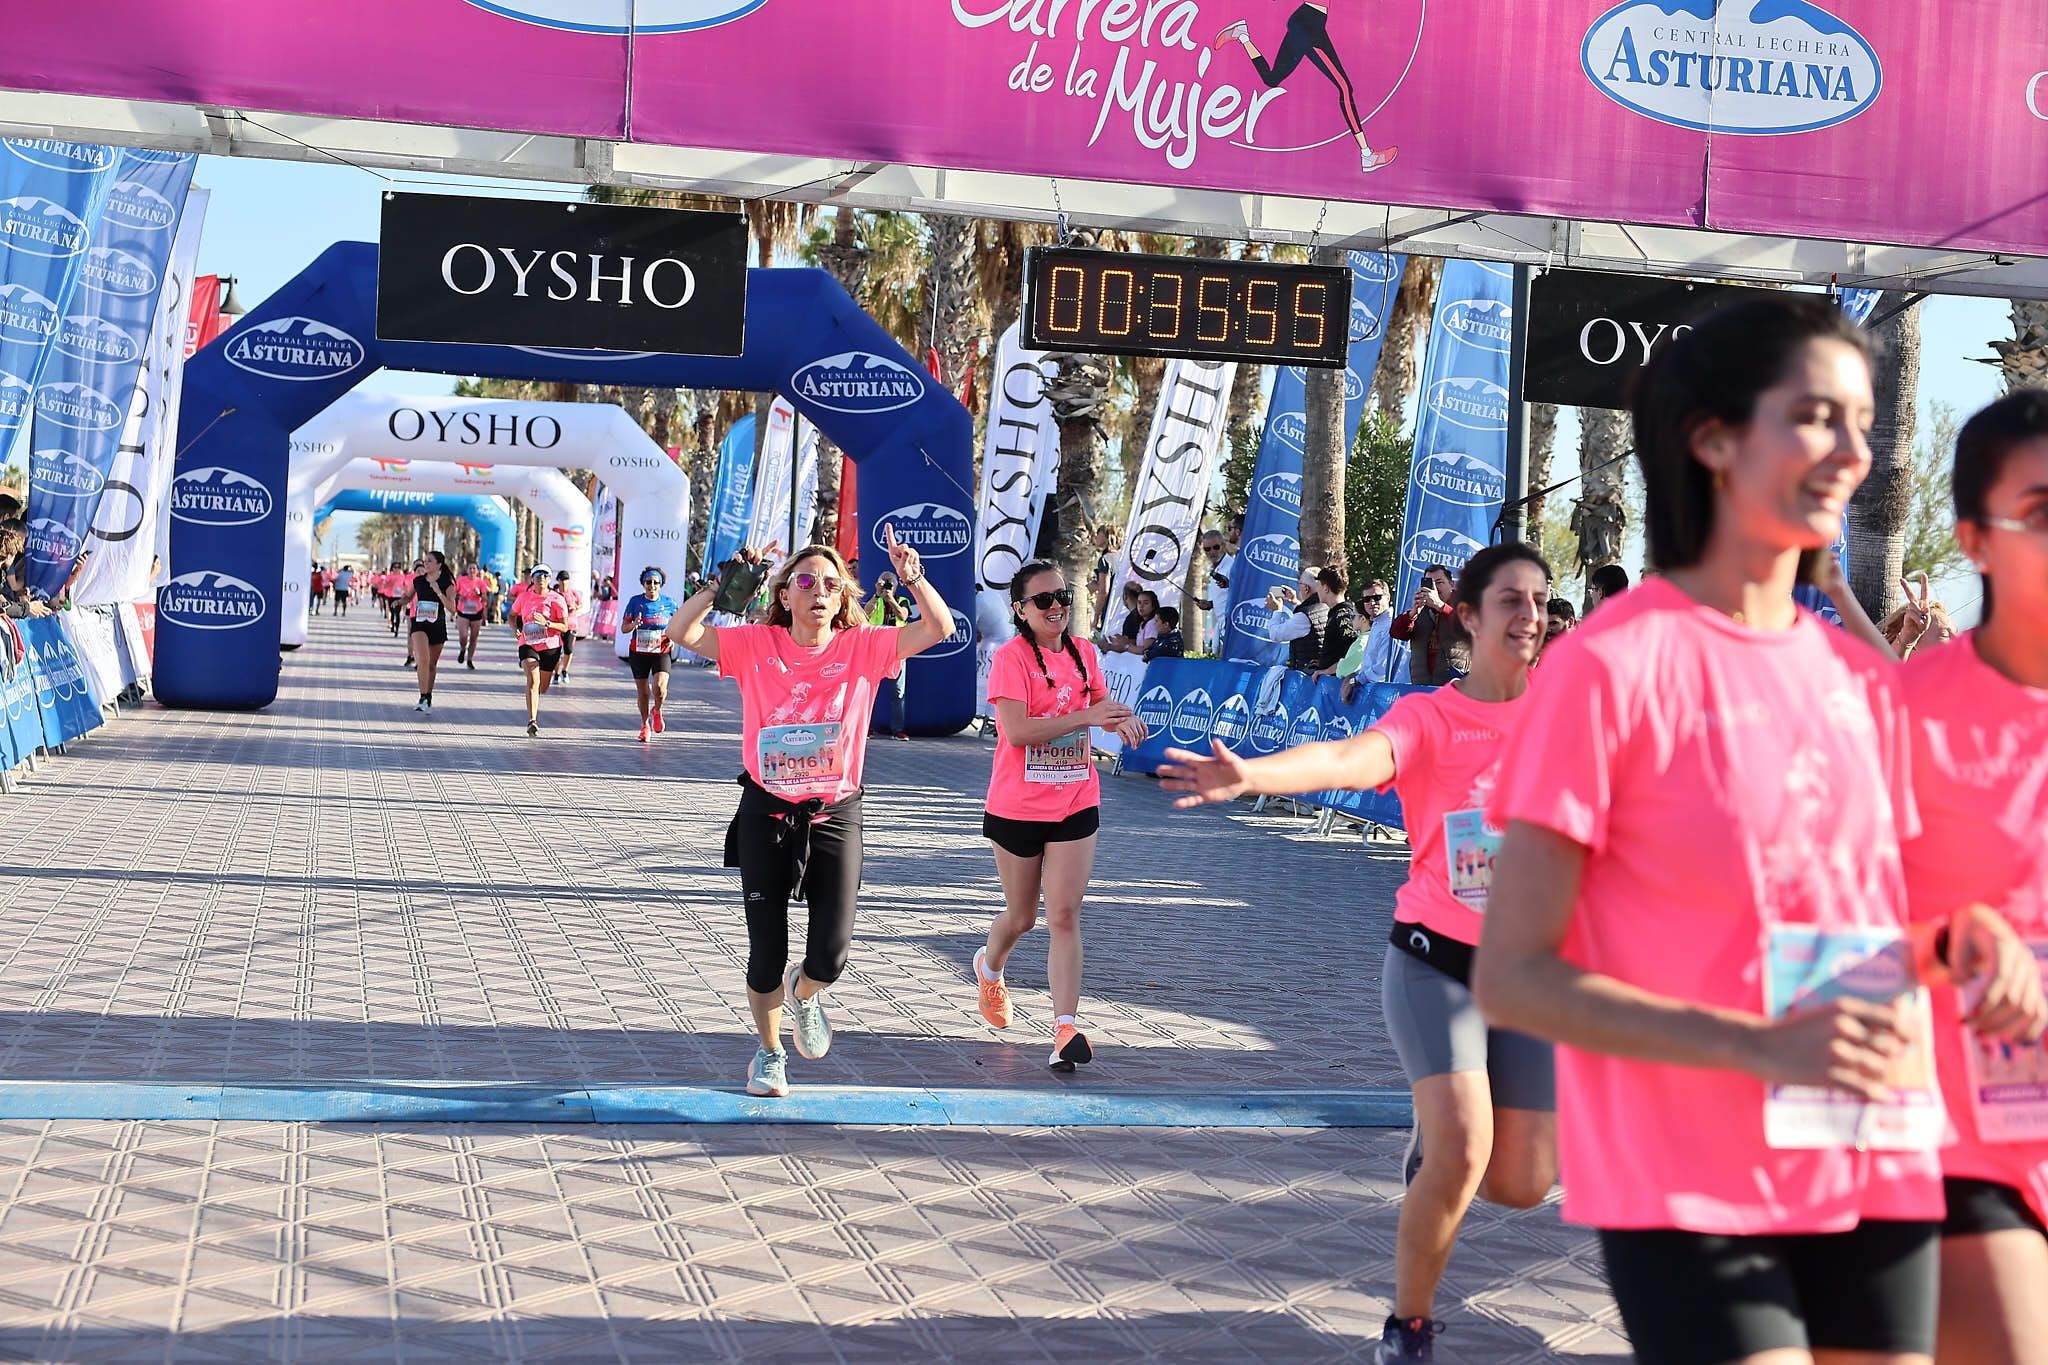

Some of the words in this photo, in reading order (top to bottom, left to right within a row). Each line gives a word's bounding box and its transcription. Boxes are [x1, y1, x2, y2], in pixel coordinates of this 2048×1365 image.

[1653, 26, 1746, 47] CENTRAL
[1756, 36, 1850, 57] LECHERA
[1008, 41, 1055, 92] de
[1064, 41, 1098, 98] la
[1603, 26, 1858, 103] ASTURIANA
[1087, 45, 1288, 169] Mujer
[441, 243, 696, 309] OYSHO
[1049, 266, 1327, 348] 00:35:55
[232, 337, 353, 367] ASTURIANA
[257, 335, 301, 346] CENTRAL
[306, 339, 352, 349] LECHERA
[802, 374, 917, 398] ASTURIANA
[388, 408, 562, 449] OYSHO
[610, 455, 661, 468] OYSHO
[1130, 358, 1222, 581] OYSH
[184, 485, 220, 494] CENTRAL
[225, 488, 263, 497] LECHERA
[1420, 463, 1501, 499] ASTURIANA
[170, 487, 265, 514] ASTURIANA
[633, 528, 680, 541] OYSHO
[164, 591, 258, 617] ASTURIANA
[177, 589, 213, 597] CENTRAL
[217, 591, 255, 599] LECHERA
[787, 756, 817, 769] 016
[1051, 747, 1074, 757] 016
